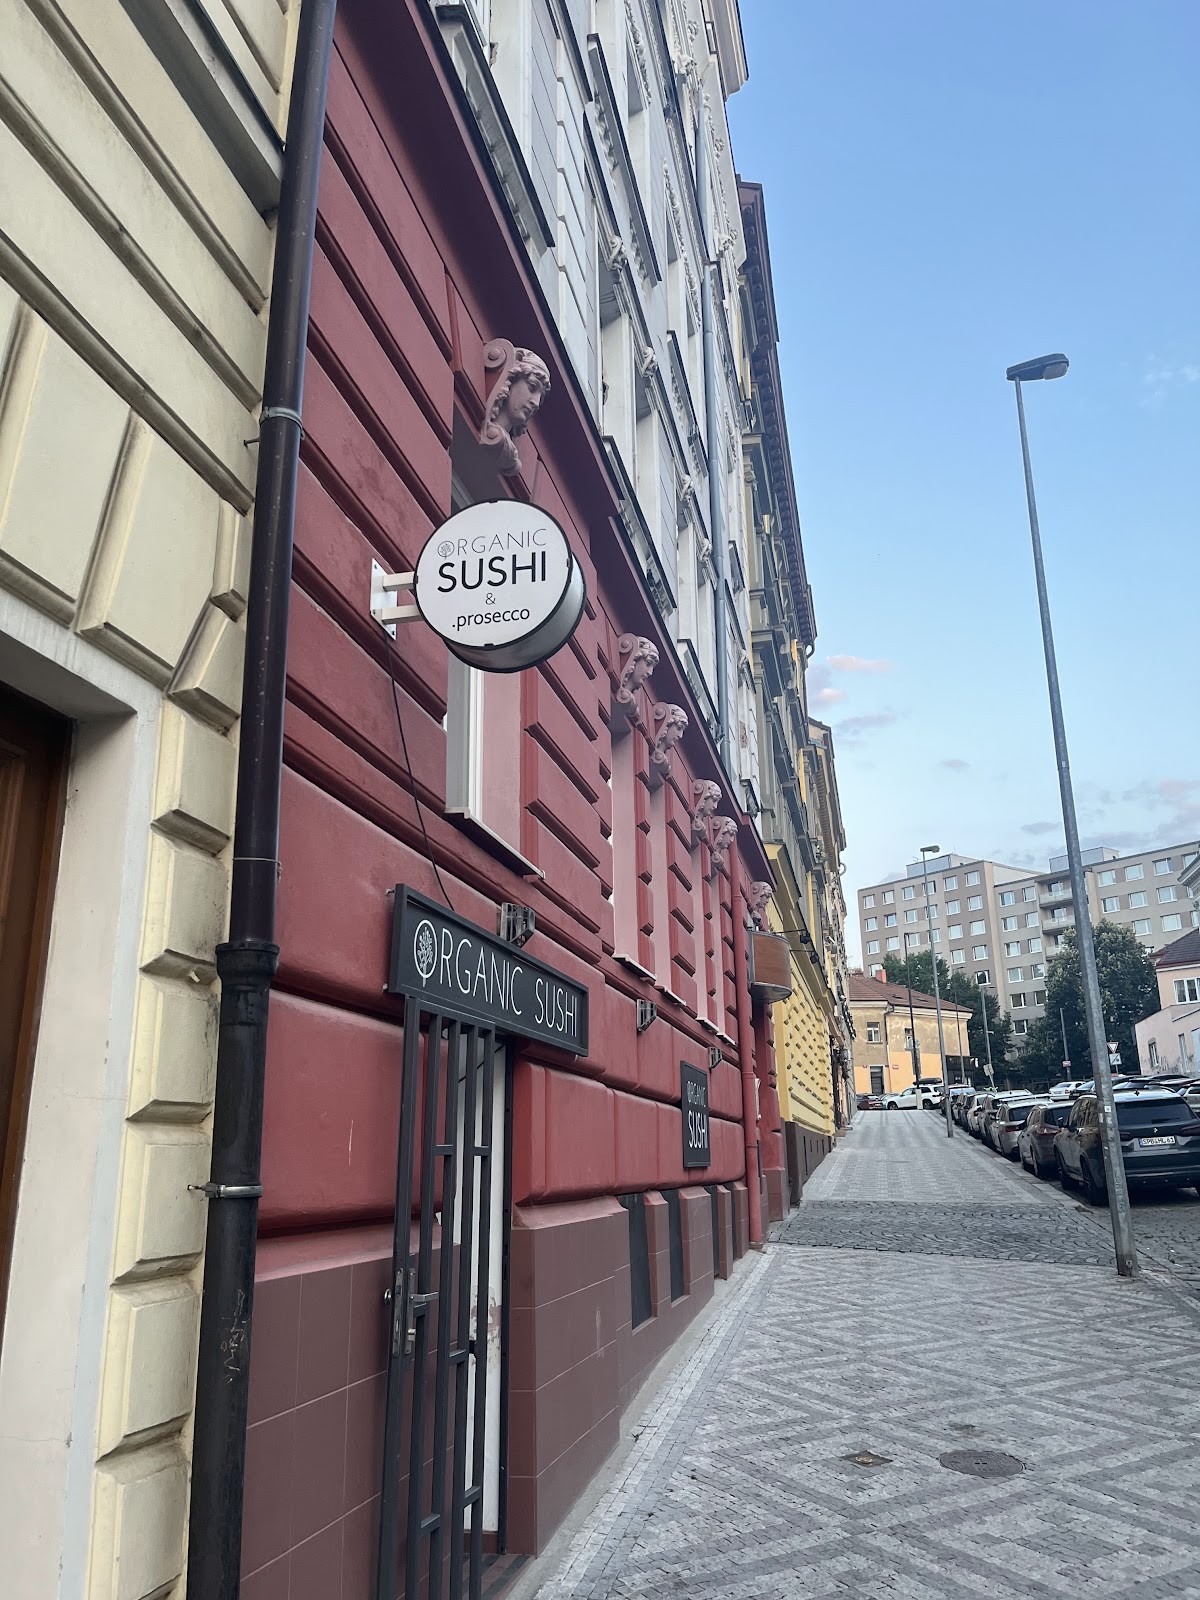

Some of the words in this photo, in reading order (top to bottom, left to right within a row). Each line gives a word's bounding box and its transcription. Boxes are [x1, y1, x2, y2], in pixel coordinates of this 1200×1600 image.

[437, 528, 547, 559] ORGANIC
[437, 550, 546, 593] SUSHI
[485, 592, 496, 606] &
[451, 608, 530, 632] .prosecco
[413, 919, 523, 1016] ORGANIC
[534, 977, 578, 1038] SUSHI
[688, 1109, 708, 1149] SUSHI
